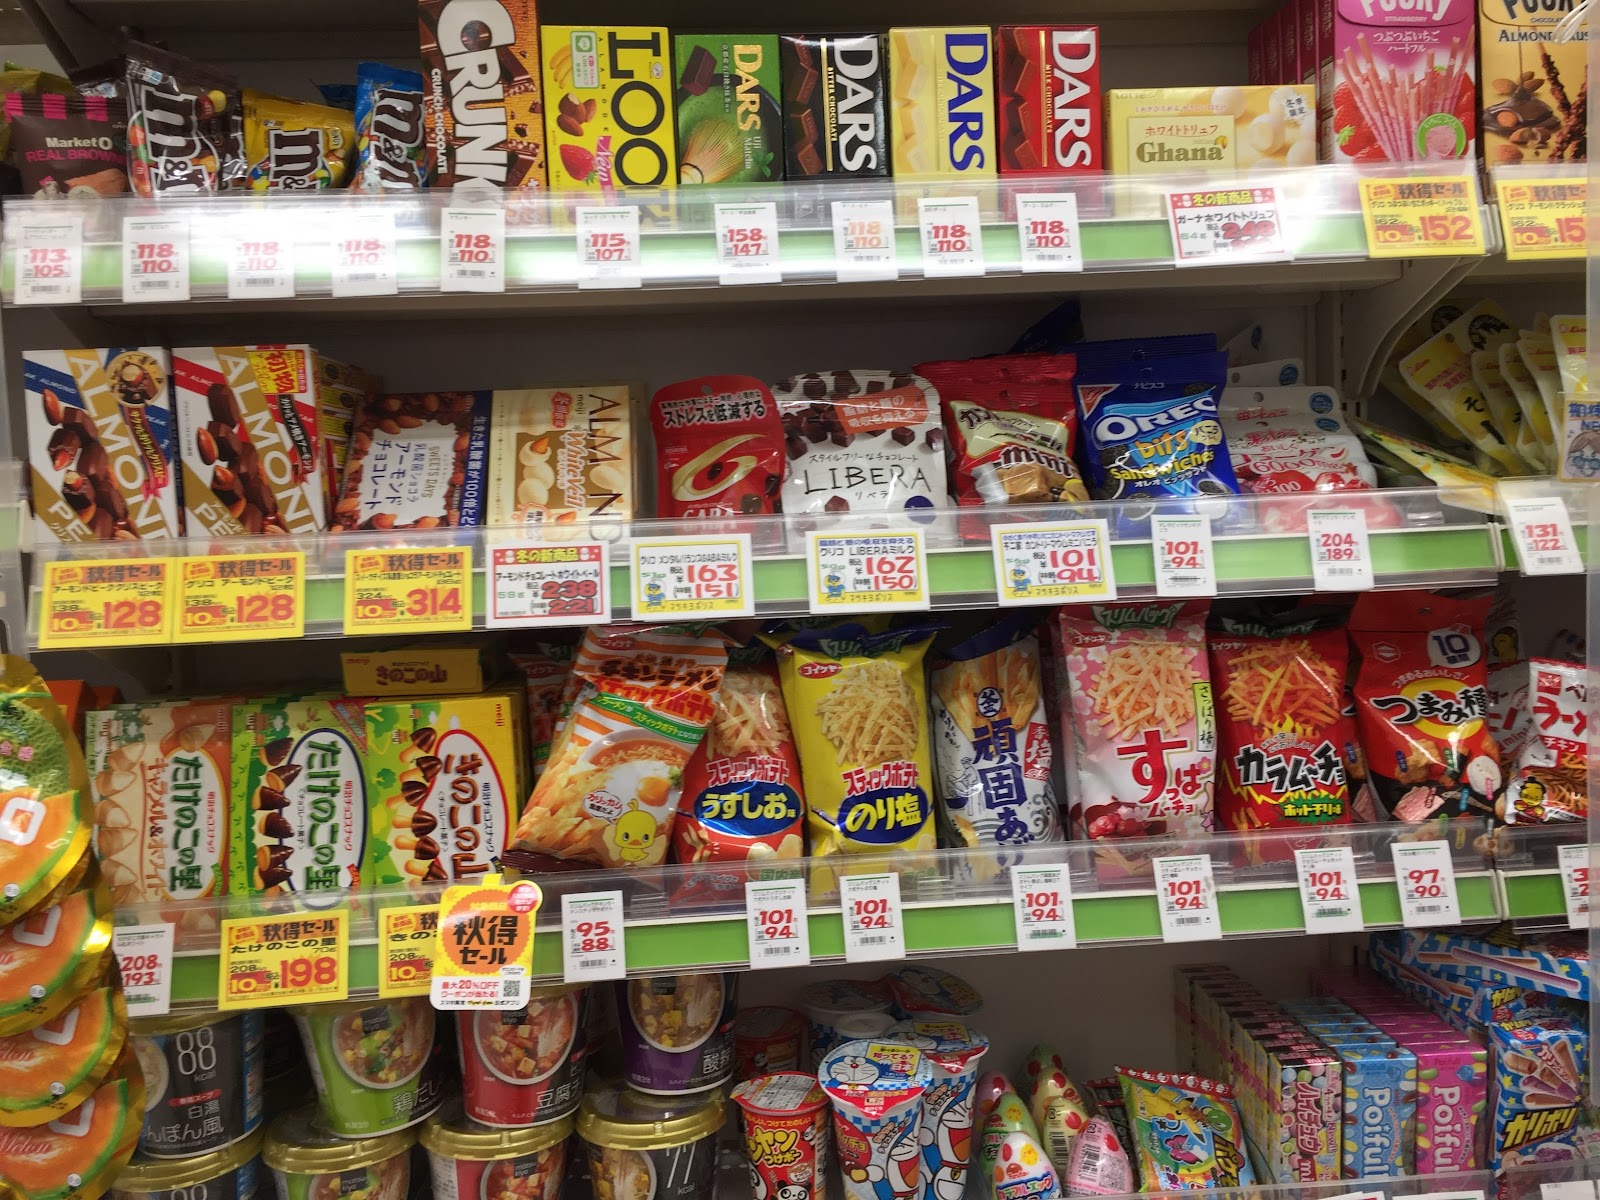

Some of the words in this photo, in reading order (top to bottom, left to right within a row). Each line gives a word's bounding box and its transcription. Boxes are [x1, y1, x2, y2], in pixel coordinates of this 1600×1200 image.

[1384, 16, 1428, 24] STRAWBERRY
[1373, 30, 1440, 44] つぶつぶいちご
[1387, 43, 1427, 54] ハートフル
[733, 44, 763, 131] DARS
[834, 37, 880, 172] DARS
[945, 33, 990, 172] DARS
[1052, 31, 1098, 169] DARS
[1046, 86, 1054, 134] CHOCOLATE
[829, 100, 838, 142] CHOCOLATE
[1143, 122, 1219, 138] ホワイトトリュフ
[434, 110, 448, 174] CHOCOLATE
[26, 149, 67, 163] REAL
[1136, 139, 1225, 164] Ghana
[1192, 189, 1253, 206] 冬の新商品
[1399, 183, 1464, 199] 秋得セール
[1177, 210, 1275, 224] ガーナホワイトトリュフ
[728, 227, 763, 243] 158
[848, 221, 881, 236] 118
[932, 224, 967, 239] 118
[1030, 220, 1065, 235] 118
[1419, 214, 1473, 241] 152
[242, 241, 280, 256] 118
[455, 234, 491, 249] 118
[590, 232, 626, 248] 115
[938, 238, 967, 253] 110
[1036, 234, 1065, 248] 110
[30, 247, 66, 264] 113
[136, 243, 175, 260] 118
[458, 249, 490, 263] 110
[594, 247, 625, 261] 107
[732, 242, 762, 256] 147
[32, 263, 66, 278] 105
[142, 259, 174, 274] 110
[575, 394, 585, 417] meiji
[663, 400, 766, 428] ストレスを低減する
[1138, 429, 1190, 461] bits
[428, 446, 441, 478] SWEETS
[808, 453, 919, 464] スタイルフリーなチョコレート
[1000, 445, 1073, 478] mini
[1110, 450, 1216, 481] Sandwiches
[364, 439, 389, 511] チョコレート
[386, 442, 411, 506] アーモンド
[406, 443, 428, 504] 乳酸菌ショコラ
[803, 465, 932, 495] LIBERA
[421, 479, 437, 498] DAYS
[854, 490, 888, 500] リベラ
[1524, 523, 1558, 538] 131
[1165, 541, 1199, 556] 101
[1321, 533, 1355, 548] 204
[1533, 538, 1560, 551] 122
[516, 548, 580, 564] 冬の新商品
[819, 546, 844, 557] グリコ
[848, 545, 915, 556] LIBERAミルク
[1050, 549, 1097, 569] 101
[1325, 547, 1354, 561] 189
[218, 560, 293, 578] 秋得セール
[388, 553, 460, 572] 秋得セール
[865, 555, 915, 575] 162
[1170, 556, 1200, 568] 94
[87, 564, 162, 583] 秋得セール
[687, 564, 738, 583] 163
[1056, 567, 1100, 583] 94
[541, 579, 599, 600] 238
[695, 583, 736, 598] 151
[874, 575, 914, 590] 150
[236, 594, 295, 624] 128
[406, 587, 463, 616] 314
[548, 599, 599, 614] 221
[103, 600, 163, 631] 128
[1096, 605, 1179, 629] スリムパック
[1432, 631, 1471, 654] 10
[601, 658, 720, 692] チキンラーメン
[803, 665, 840, 677] コイケヤ
[1371, 684, 1487, 725] つまみ種
[496, 702, 504, 727] meiji
[1542, 735, 1582, 753] チキン
[706, 758, 790, 787] スティックポテト
[1235, 740, 1347, 793] カラムーチョ
[842, 760, 919, 795] スティックポテト
[304, 739, 343, 891] たけのこの里
[442, 750, 493, 880] きのこの山
[845, 793, 923, 832] のり塩
[1146, 803, 1194, 818] ムーチョ
[146, 757, 169, 898] キャラメル&ホワイト
[168, 756, 205, 893] たけのこの里
[1309, 871, 1342, 887] 101
[1408, 868, 1440, 884] 97
[1167, 880, 1202, 897] 101
[1315, 887, 1344, 901] 94
[1414, 884, 1442, 898] 90
[854, 898, 888, 916] 101
[1025, 891, 1059, 908] 101
[1174, 896, 1203, 910] 94
[759, 908, 793, 926] 101
[859, 915, 888, 929] 94
[1031, 908, 1060, 922] 94
[263, 920, 336, 941] 秋得セール
[453, 915, 519, 946] 秋得
[576, 921, 612, 938] 95
[764, 925, 792, 939] 94
[230, 937, 337, 954] たけのこの里
[581, 938, 611, 952] 88
[121, 955, 158, 971] 208
[459, 947, 508, 966] セール
[124, 971, 155, 986] 193
[280, 956, 337, 989] 198
